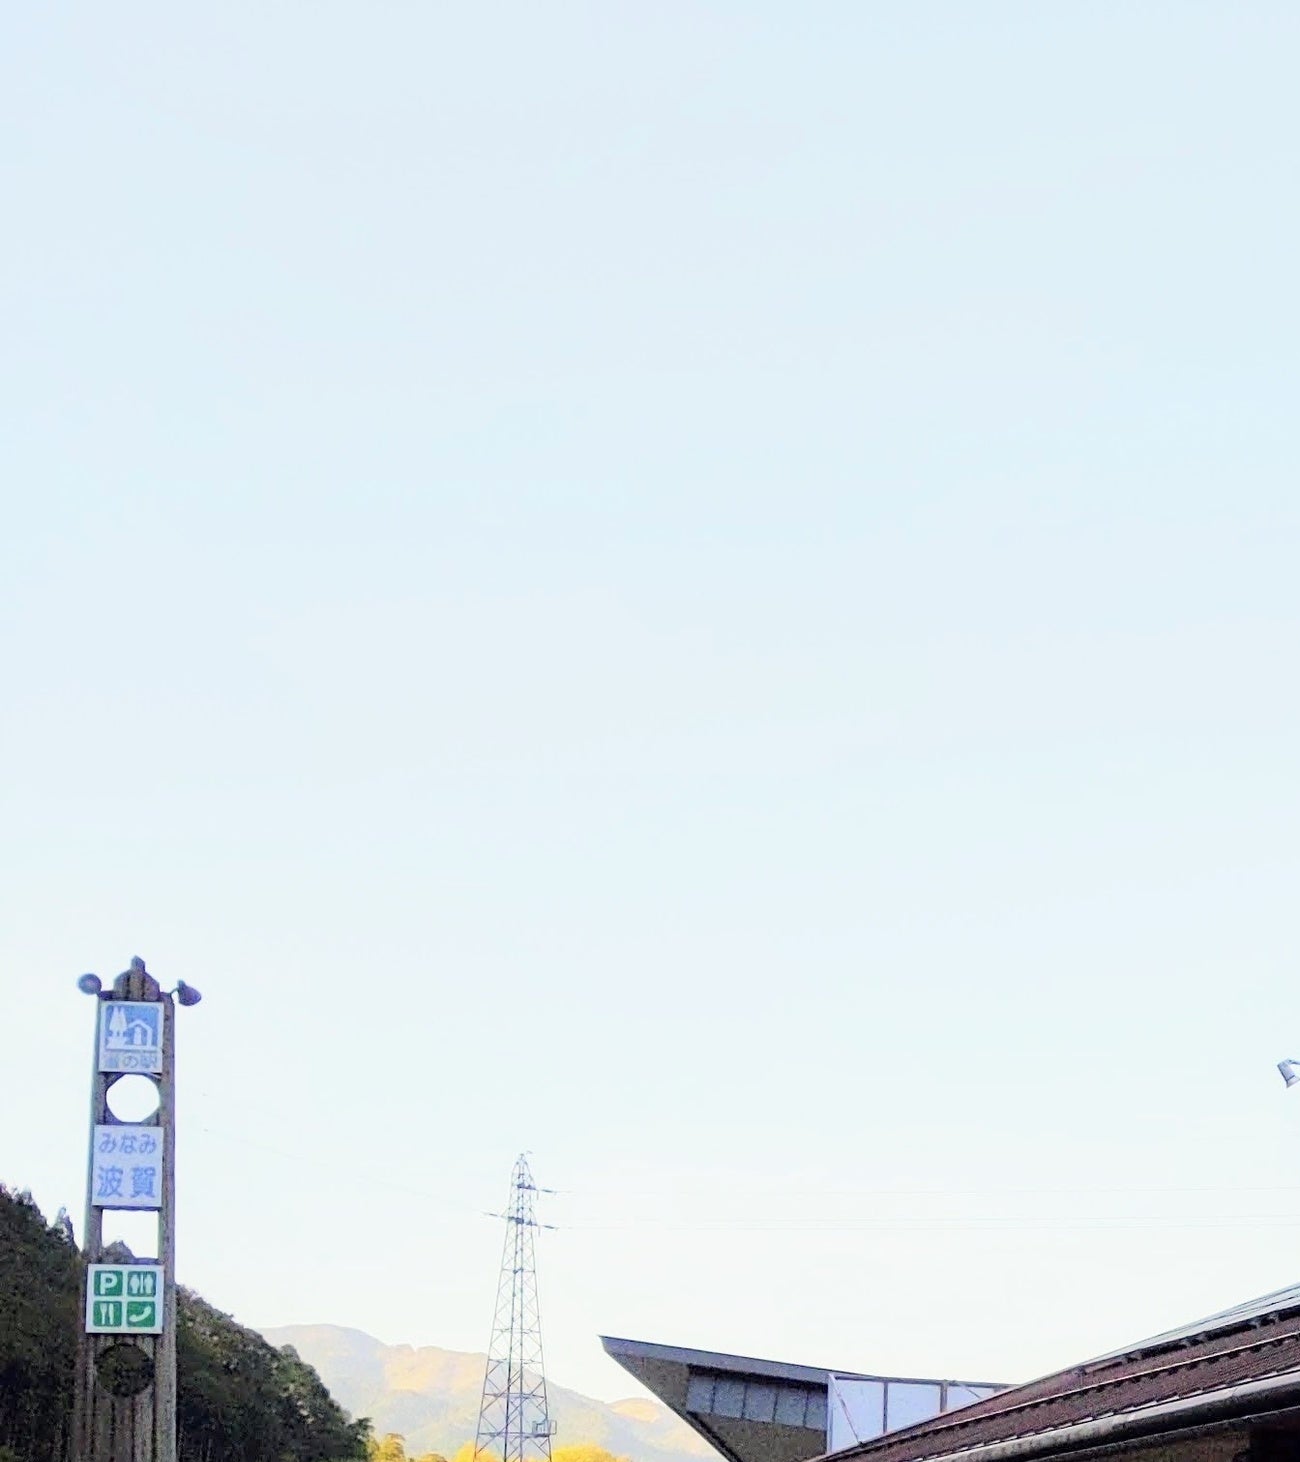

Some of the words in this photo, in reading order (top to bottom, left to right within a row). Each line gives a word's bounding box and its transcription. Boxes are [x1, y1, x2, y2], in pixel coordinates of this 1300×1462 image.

[100, 1132, 157, 1154] みなみ
[97, 1166, 156, 1199] 波賀
[100, 1272, 118, 1295] P
